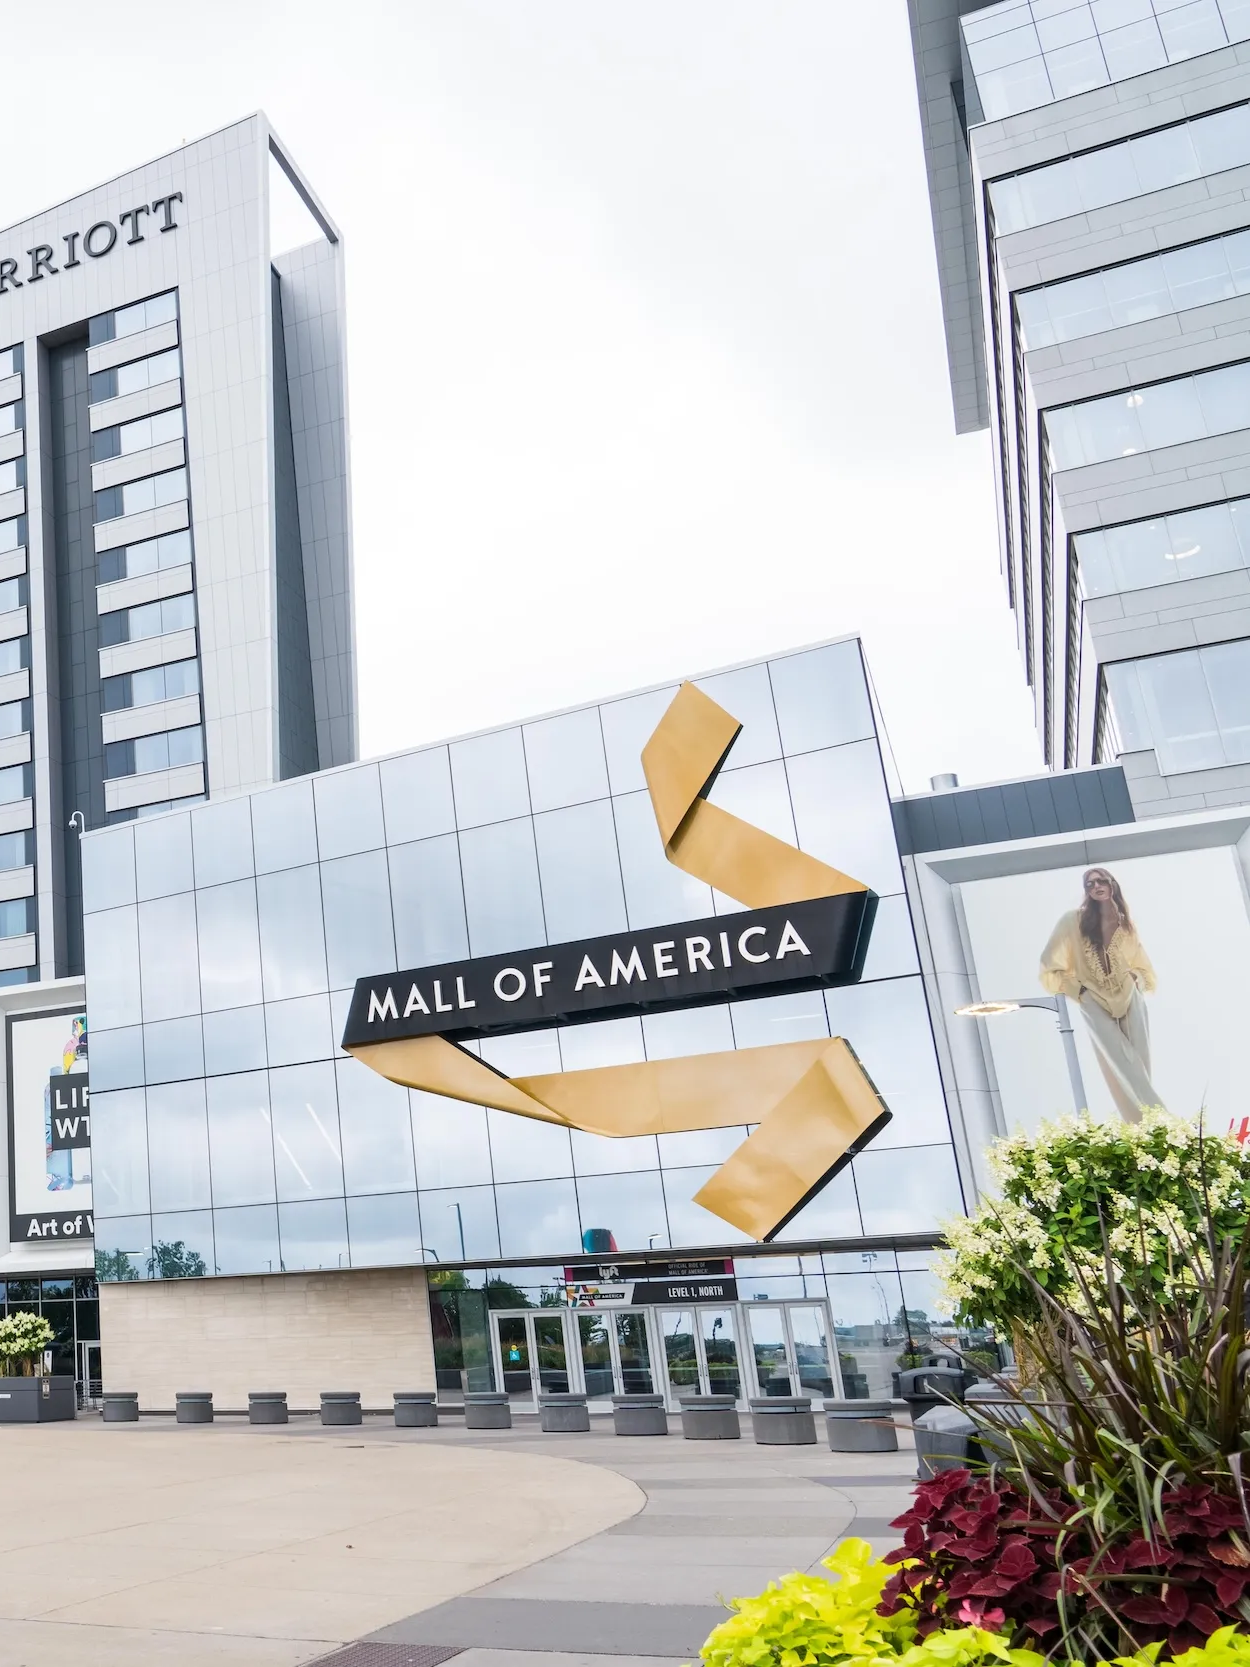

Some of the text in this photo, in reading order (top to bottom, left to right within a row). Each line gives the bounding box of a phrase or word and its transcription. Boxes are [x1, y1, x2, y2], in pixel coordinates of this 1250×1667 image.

[367, 919, 812, 1023] MALL OF AMERICA
[27, 1218, 58, 1237] Art
[62, 1215, 83, 1235] of
[668, 1285, 724, 1298] LEVEL 1, NORTH
